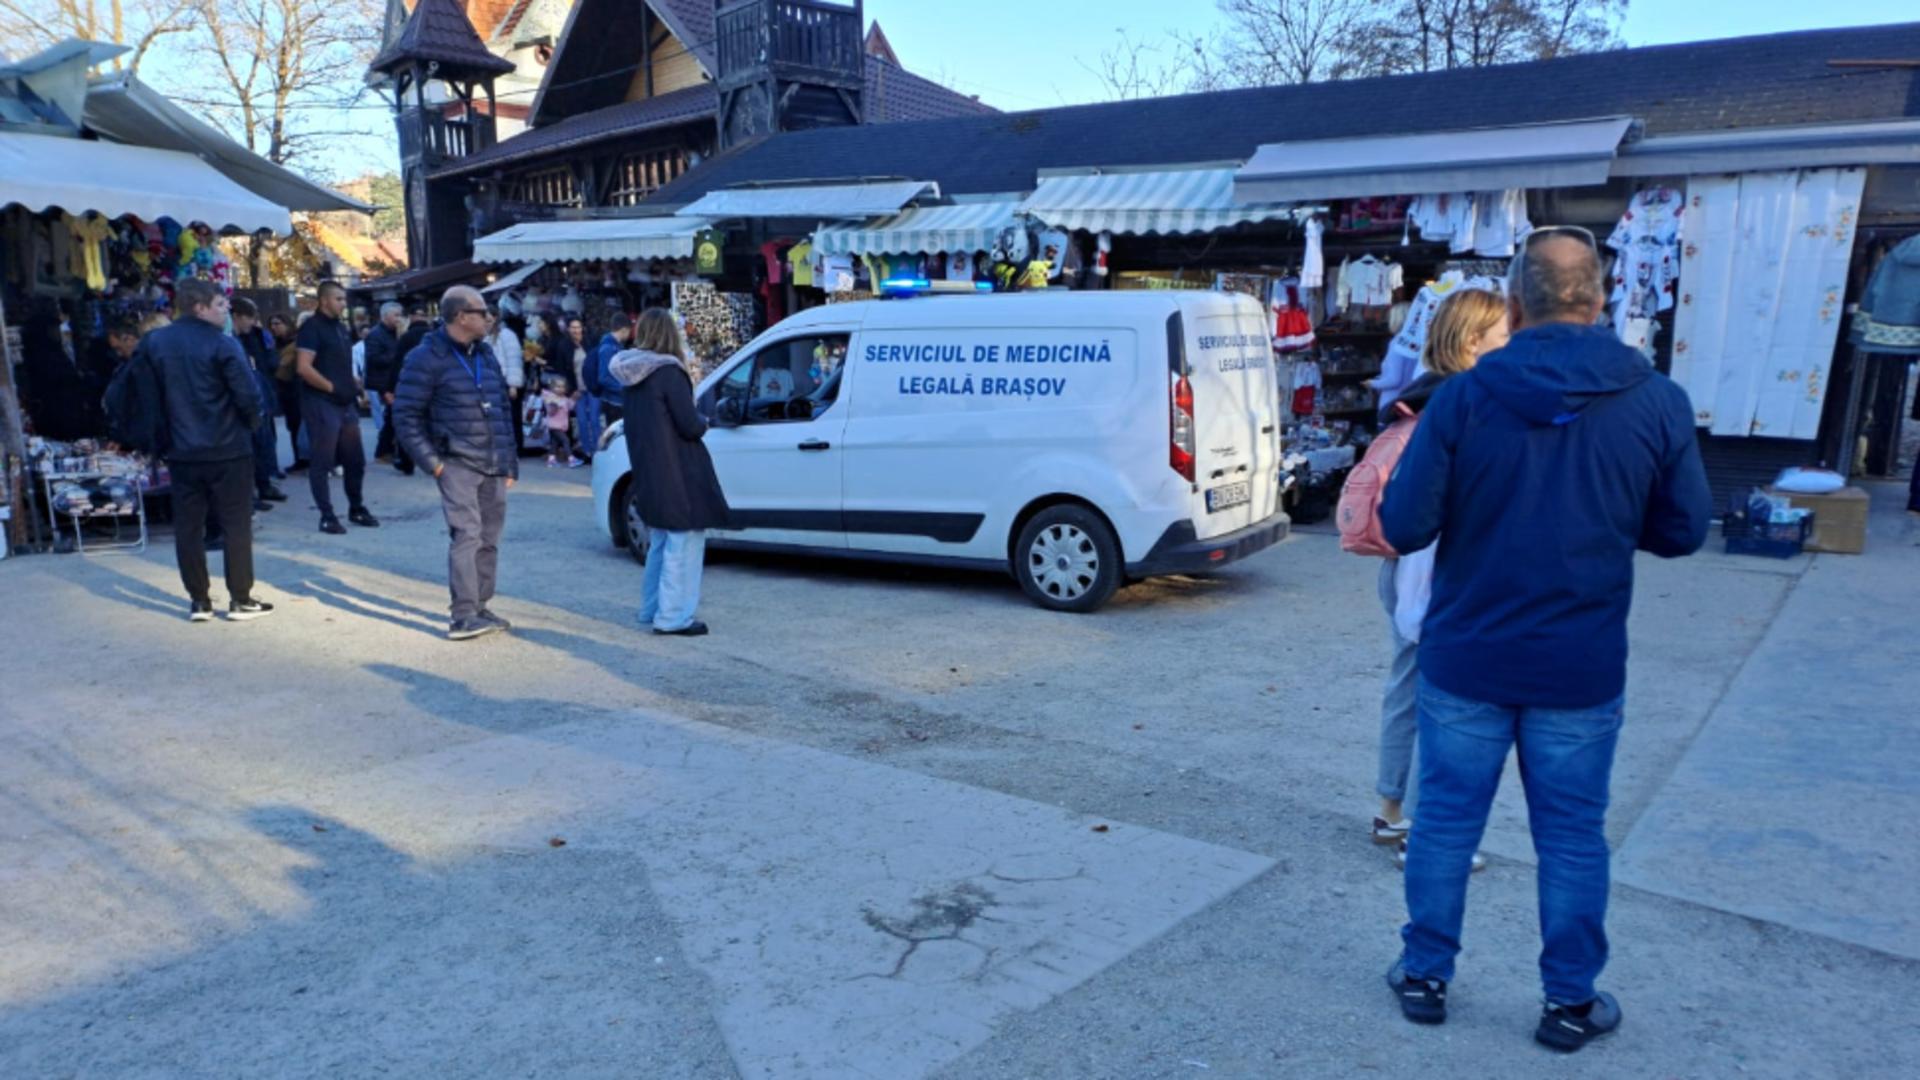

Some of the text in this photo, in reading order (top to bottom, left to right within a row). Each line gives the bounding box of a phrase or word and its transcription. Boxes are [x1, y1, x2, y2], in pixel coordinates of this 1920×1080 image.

[865, 339, 1111, 362] SERVICIUL DE MEDICINĂ
[899, 373, 1065, 401] LEGALĂ BRAȘOV
